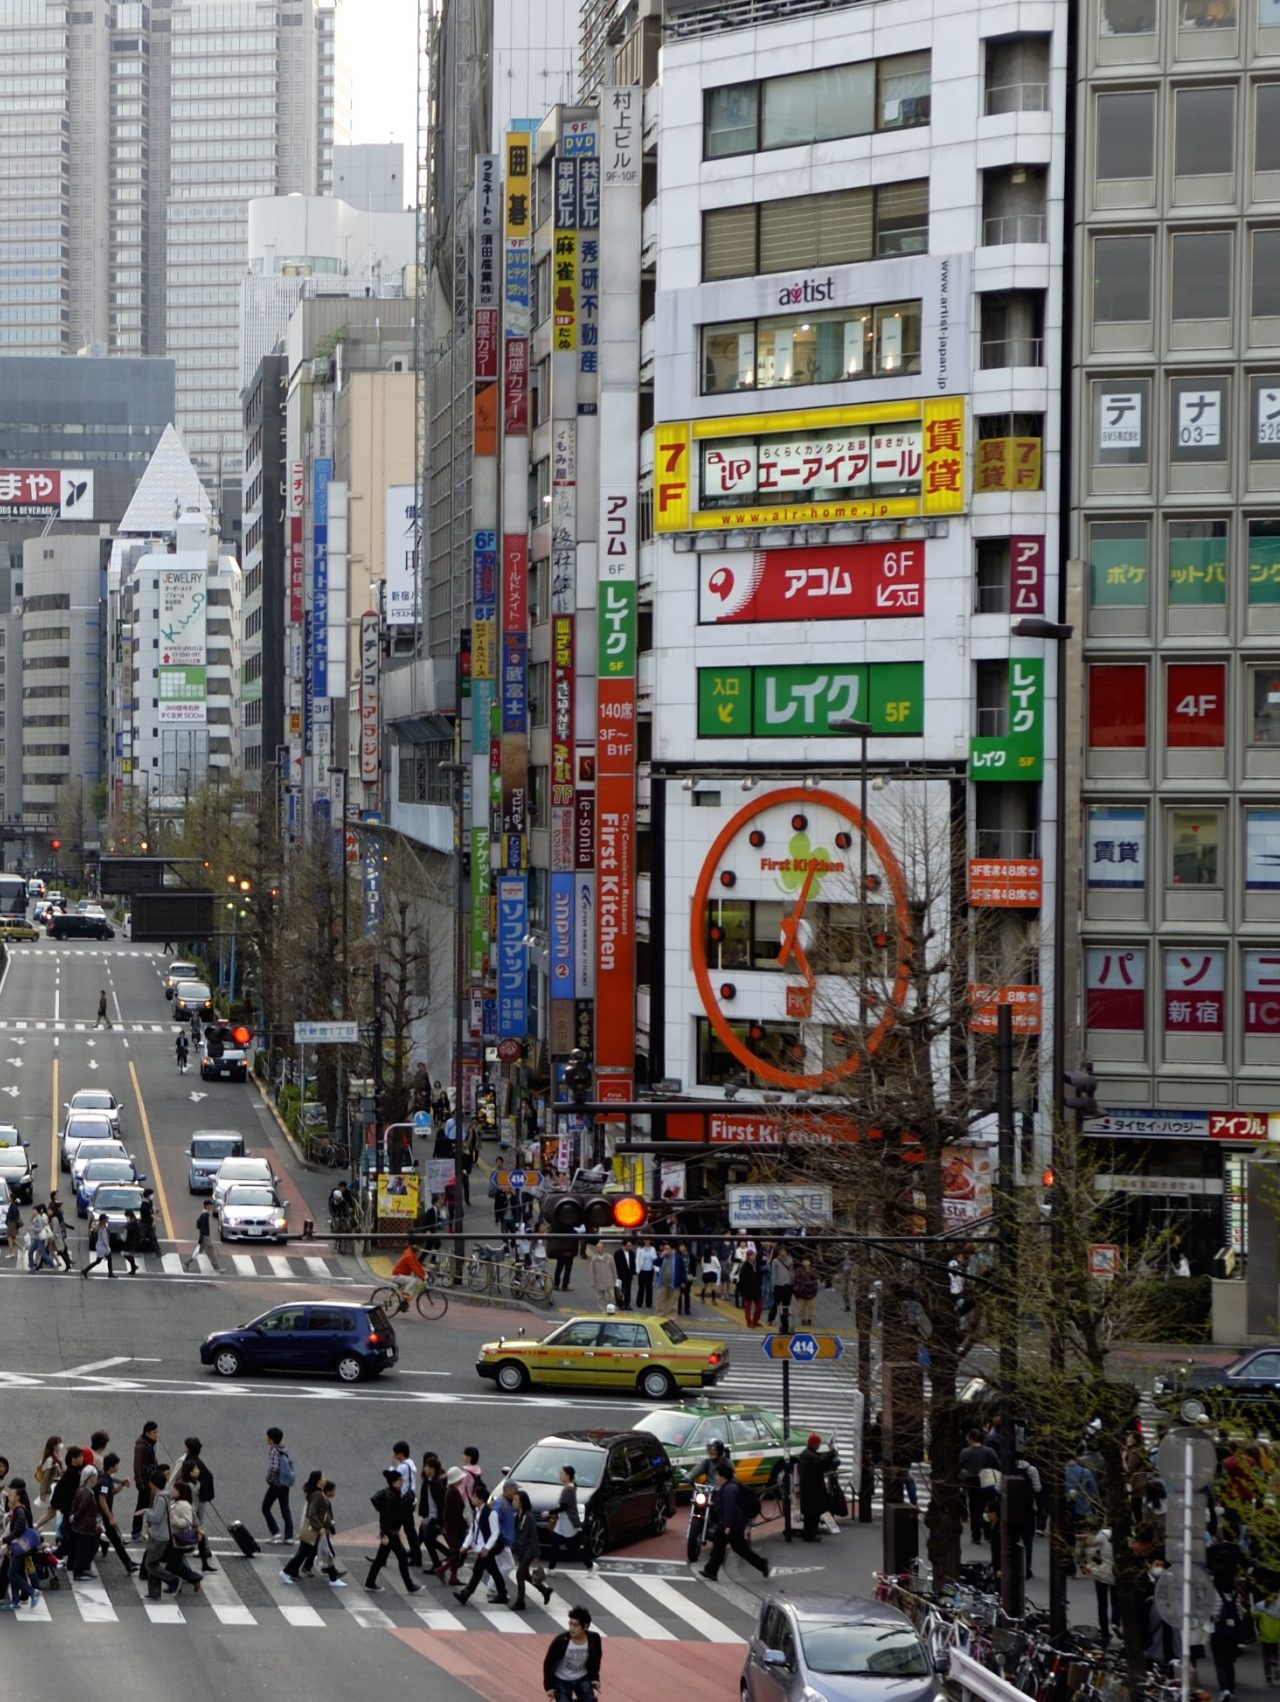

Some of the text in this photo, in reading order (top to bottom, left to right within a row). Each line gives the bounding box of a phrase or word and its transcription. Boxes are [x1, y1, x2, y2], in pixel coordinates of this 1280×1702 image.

[566, 138, 593, 148] DVD
[613, 91, 632, 168] 村上ビル
[482, 161, 493, 225] ラミネートの
[509, 146, 528, 226] 囲碁
[558, 162, 574, 226] 甲新ビル
[582, 162, 598, 226] 共新ビル
[556, 236, 574, 281] 麻雀
[580, 241, 598, 373] 秀研不動産
[937, 260, 950, 390] www.artist-japan.jp
[476, 311, 489, 376] 銀座カラー
[508, 342, 524, 418] 銀座カラー
[757, 449, 923, 488] エーアイアール
[926, 418, 962, 494] 賃貸
[981, 441, 1005, 488] 賃貸
[659, 443, 687, 513] 7F
[607, 497, 627, 555] アコム
[721, 503, 889, 525] www.air-home.jp
[475, 532, 496, 549] 6F
[163, 573, 202, 584] JEWELRY
[608, 564, 625, 575] 6F
[883, 551, 915, 577] 6F
[1016, 542, 1039, 608] アコム
[785, 567, 853, 599] アコム
[475, 607, 495, 621] 5F
[896, 591, 919, 608] 入口
[605, 587, 628, 654] レイク
[363, 622, 378, 686] パチンコ
[609, 662, 624, 671] 5F
[506, 666, 524, 715] 武富士
[713, 677, 739, 696] 入口
[766, 675, 860, 724] レイク
[1012, 663, 1035, 732] レイク
[315, 705, 331, 713] 3F
[600, 703, 633, 719] 140席
[885, 702, 911, 723] 5F
[1176, 695, 1217, 716] 4F
[363, 705, 377, 774] アラジン
[607, 745, 633, 756] B1F
[973, 751, 1007, 767] レイク
[1019, 757, 1035, 768] 5F
[476, 831, 489, 893] チケット
[761, 858, 791, 871] First
[1093, 840, 1141, 864] 賃貸
[601, 813, 619, 970] First Kitchen
[502, 903, 524, 990] ソフマップ
[1168, 1001, 1219, 1025] 新宿
[711, 1120, 754, 1142] First
[1210, 1116, 1267, 1135] アイフル
[511, 1174, 525, 1183] 414
[738, 1194, 824, 1211] 西新宿一丁目
[792, 1340, 815, 1355] 414
